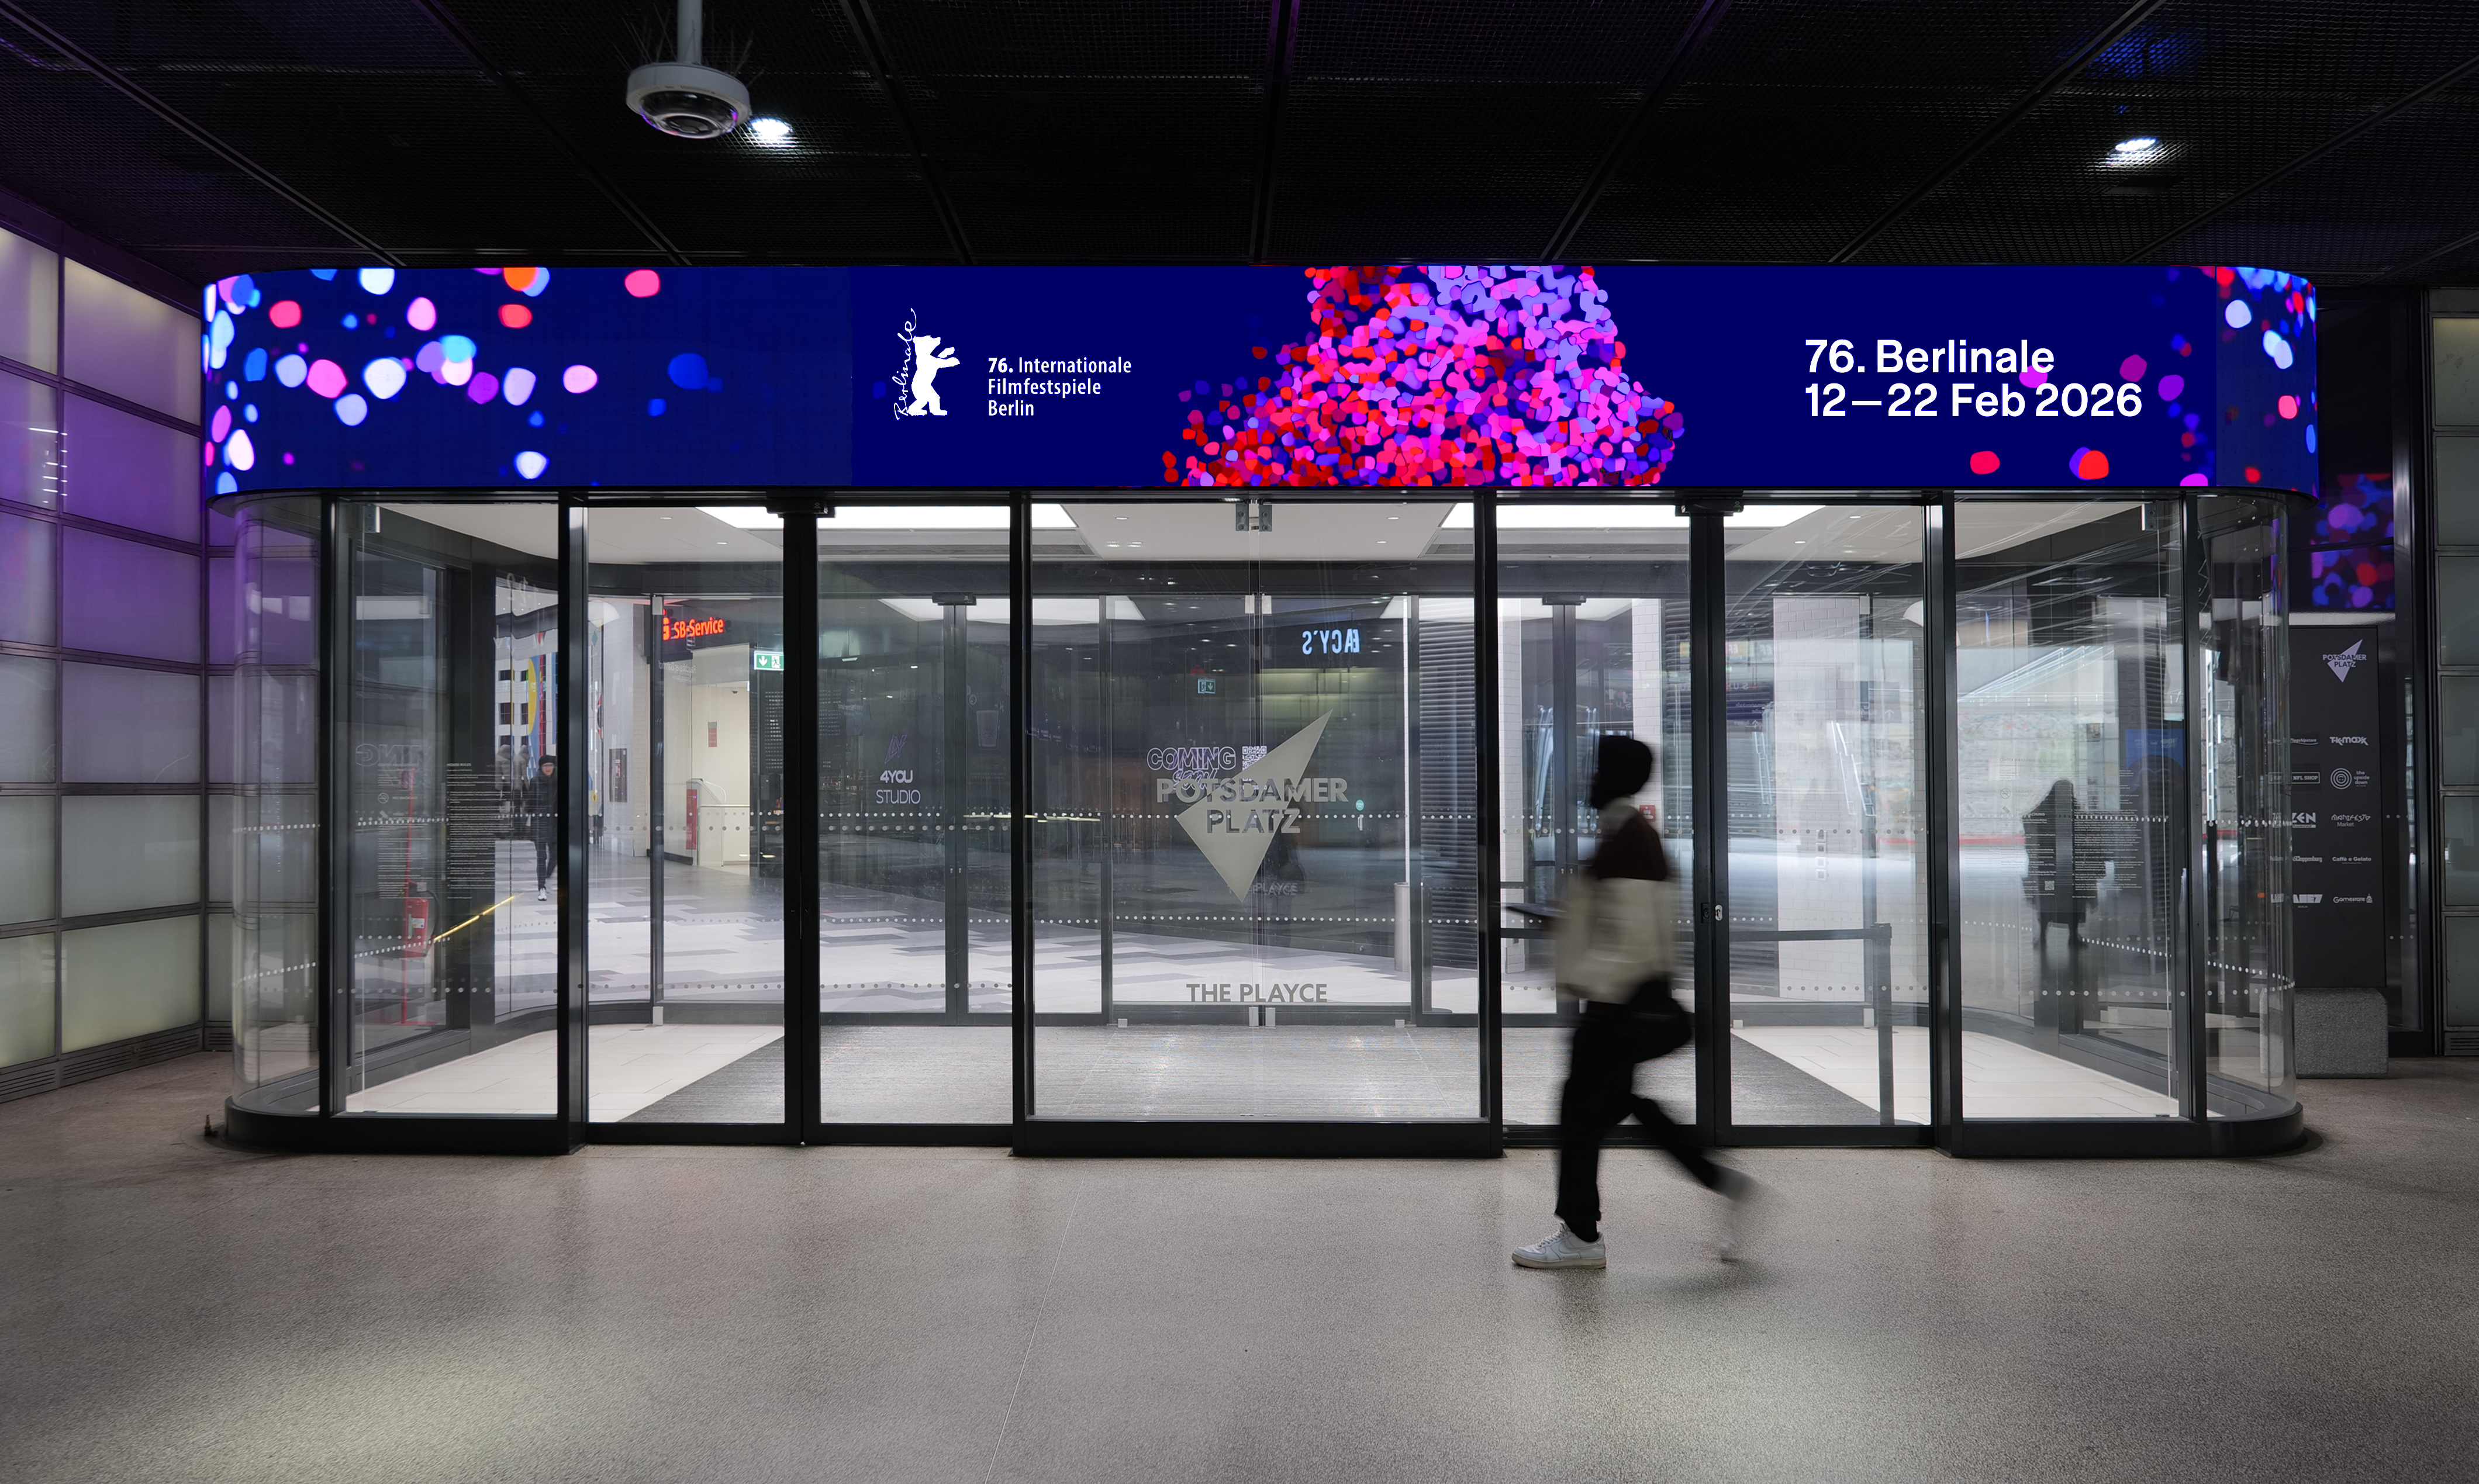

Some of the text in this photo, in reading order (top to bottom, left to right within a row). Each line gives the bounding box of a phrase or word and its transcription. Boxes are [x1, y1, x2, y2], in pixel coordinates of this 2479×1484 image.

[892, 307, 917, 420] Berlinale
[988, 357, 1131, 373] 76. Internationale
[1805, 339, 2055, 373] 76. Berlinale
[989, 378, 1101, 399] Filmfestspiele
[1952, 383, 2025, 417] Feb
[2035, 383, 2142, 417] 2026
[989, 399, 1034, 416] Berlin
[673, 616, 725, 639] SB-Service
[1147, 746, 1237, 771] COMING
[880, 770, 913, 784] 4YOU
[876, 789, 921, 805] STUDIO
[1156, 777, 1349, 803] POTSDAMER
[1206, 808, 1301, 834] PLATZ
[1186, 983, 1328, 1002] THE PLAYCE
